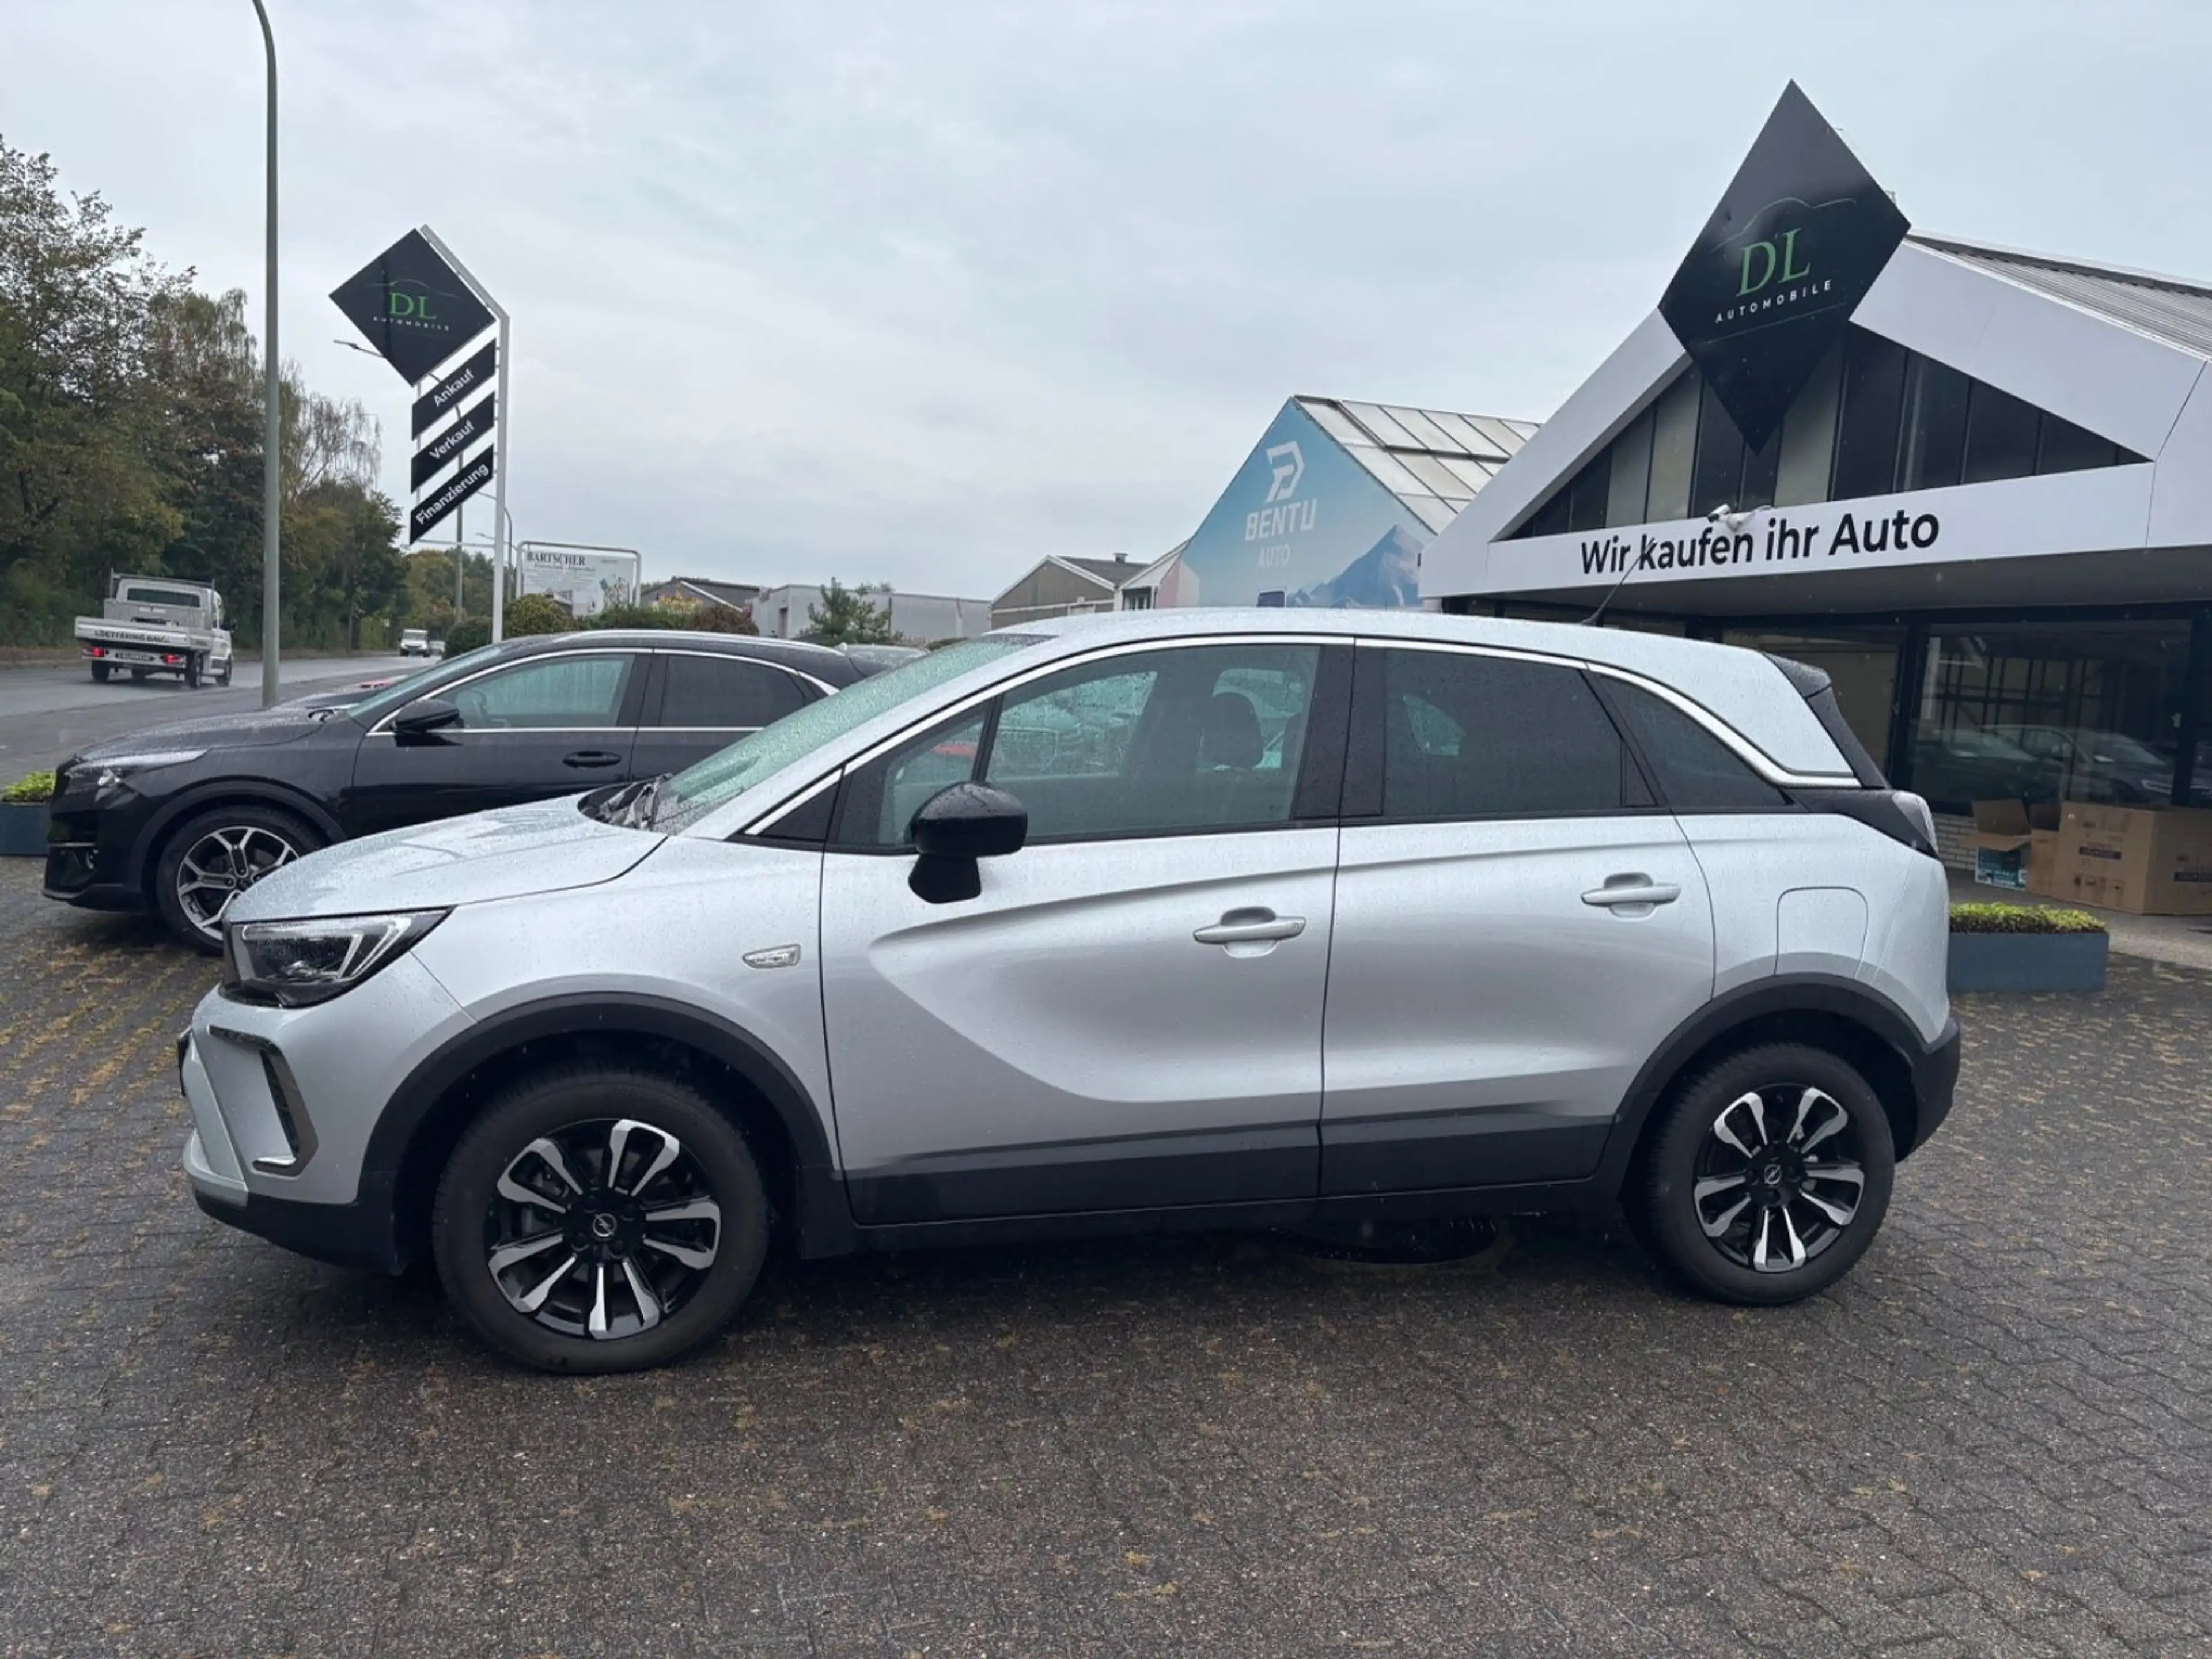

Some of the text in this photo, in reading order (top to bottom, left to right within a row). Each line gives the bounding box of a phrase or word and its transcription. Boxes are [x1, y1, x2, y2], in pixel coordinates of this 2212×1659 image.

[1736, 228, 1811, 297] DL
[388, 292, 437, 320] DL
[1715, 279, 1832, 323] AUTOMOBILE
[433, 368, 475, 407] Ankauf
[429, 419, 475, 459] Verkauf
[415, 464, 490, 525] Finanzierung
[1245, 498, 1318, 541] BENTU
[527, 551, 585, 566] BARTSCHER
[1257, 544, 1291, 569] AUTO
[1581, 509, 1940, 574] Wir kaufen ihr Auto
